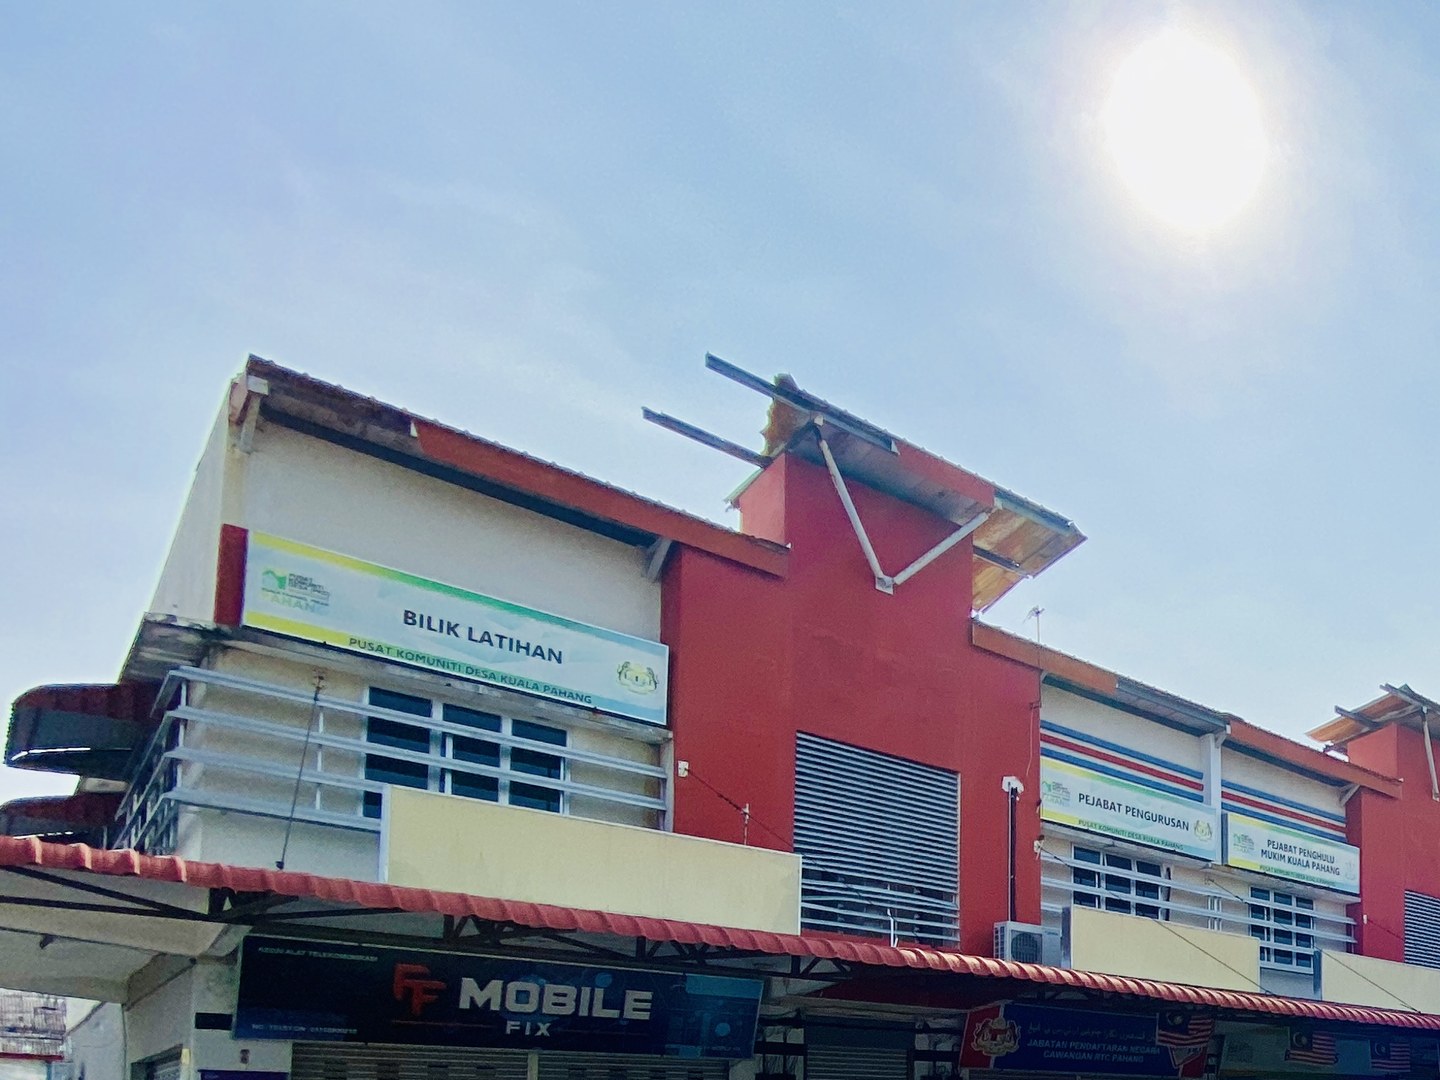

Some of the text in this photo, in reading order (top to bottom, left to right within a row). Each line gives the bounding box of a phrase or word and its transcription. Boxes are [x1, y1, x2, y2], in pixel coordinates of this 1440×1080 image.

[404, 610, 562, 664] BILIK LATIHAN
[349, 637, 591, 703] PUSAT KOMUNITI DESA KUALA PAHANG
[1079, 793, 1122, 812] PEJABAT
[1126, 806, 1188, 831] PENGURUSAN
[1261, 849, 1340, 876] MUKIM KUALA PAHANG
[1268, 840, 1298, 854] PEJABAT
[1299, 848, 1335, 864] PENGHULU
[459, 976, 654, 1021] MOBILE
[505, 1021, 551, 1037] FIX
[1027, 1039, 1067, 1049] JABATAN
